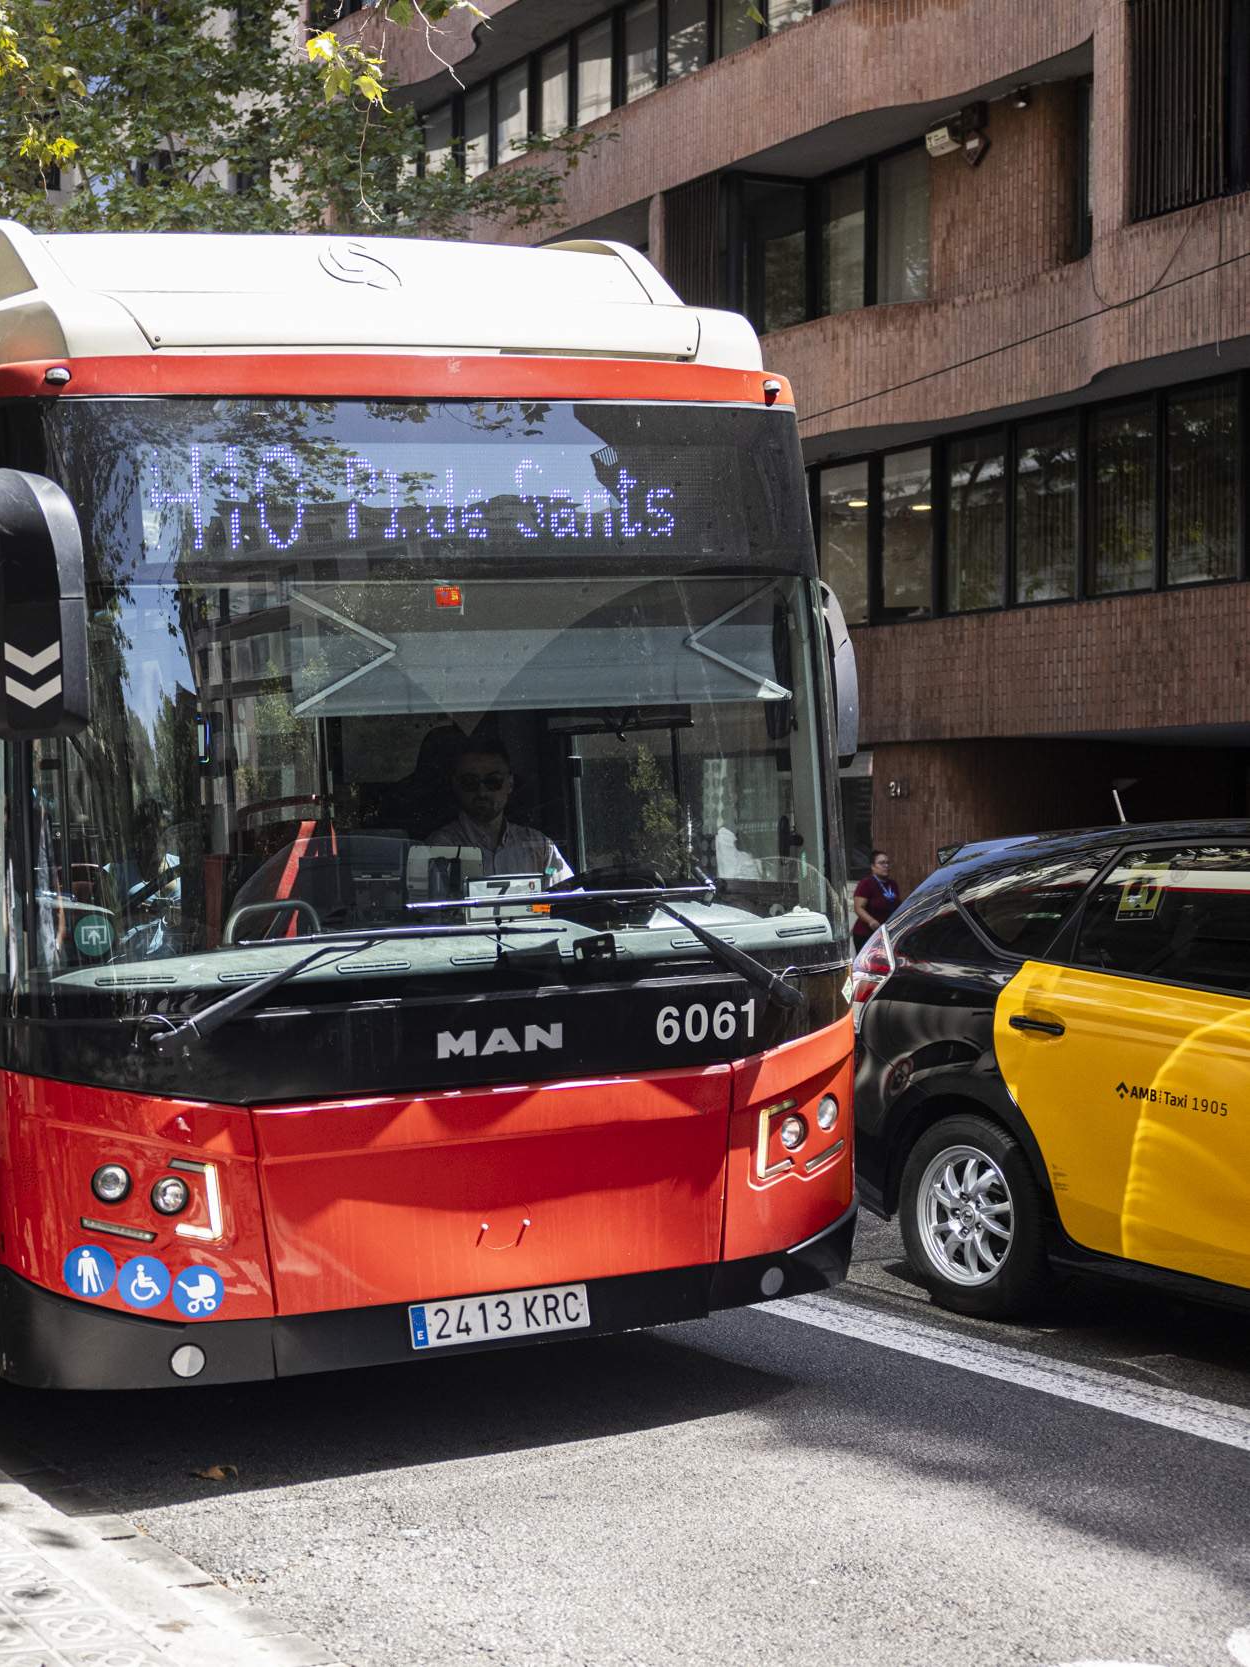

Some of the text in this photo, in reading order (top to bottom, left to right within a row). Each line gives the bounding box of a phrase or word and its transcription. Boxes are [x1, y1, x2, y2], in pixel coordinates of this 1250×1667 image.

[150, 445, 305, 549] H10
[513, 458, 675, 538] Sants
[437, 1022, 563, 1060] MAN
[655, 998, 756, 1046] 6061
[1130, 1085, 1229, 1117] AMB Taxi 1905
[416, 1291, 581, 1341] E 2413 KRC
